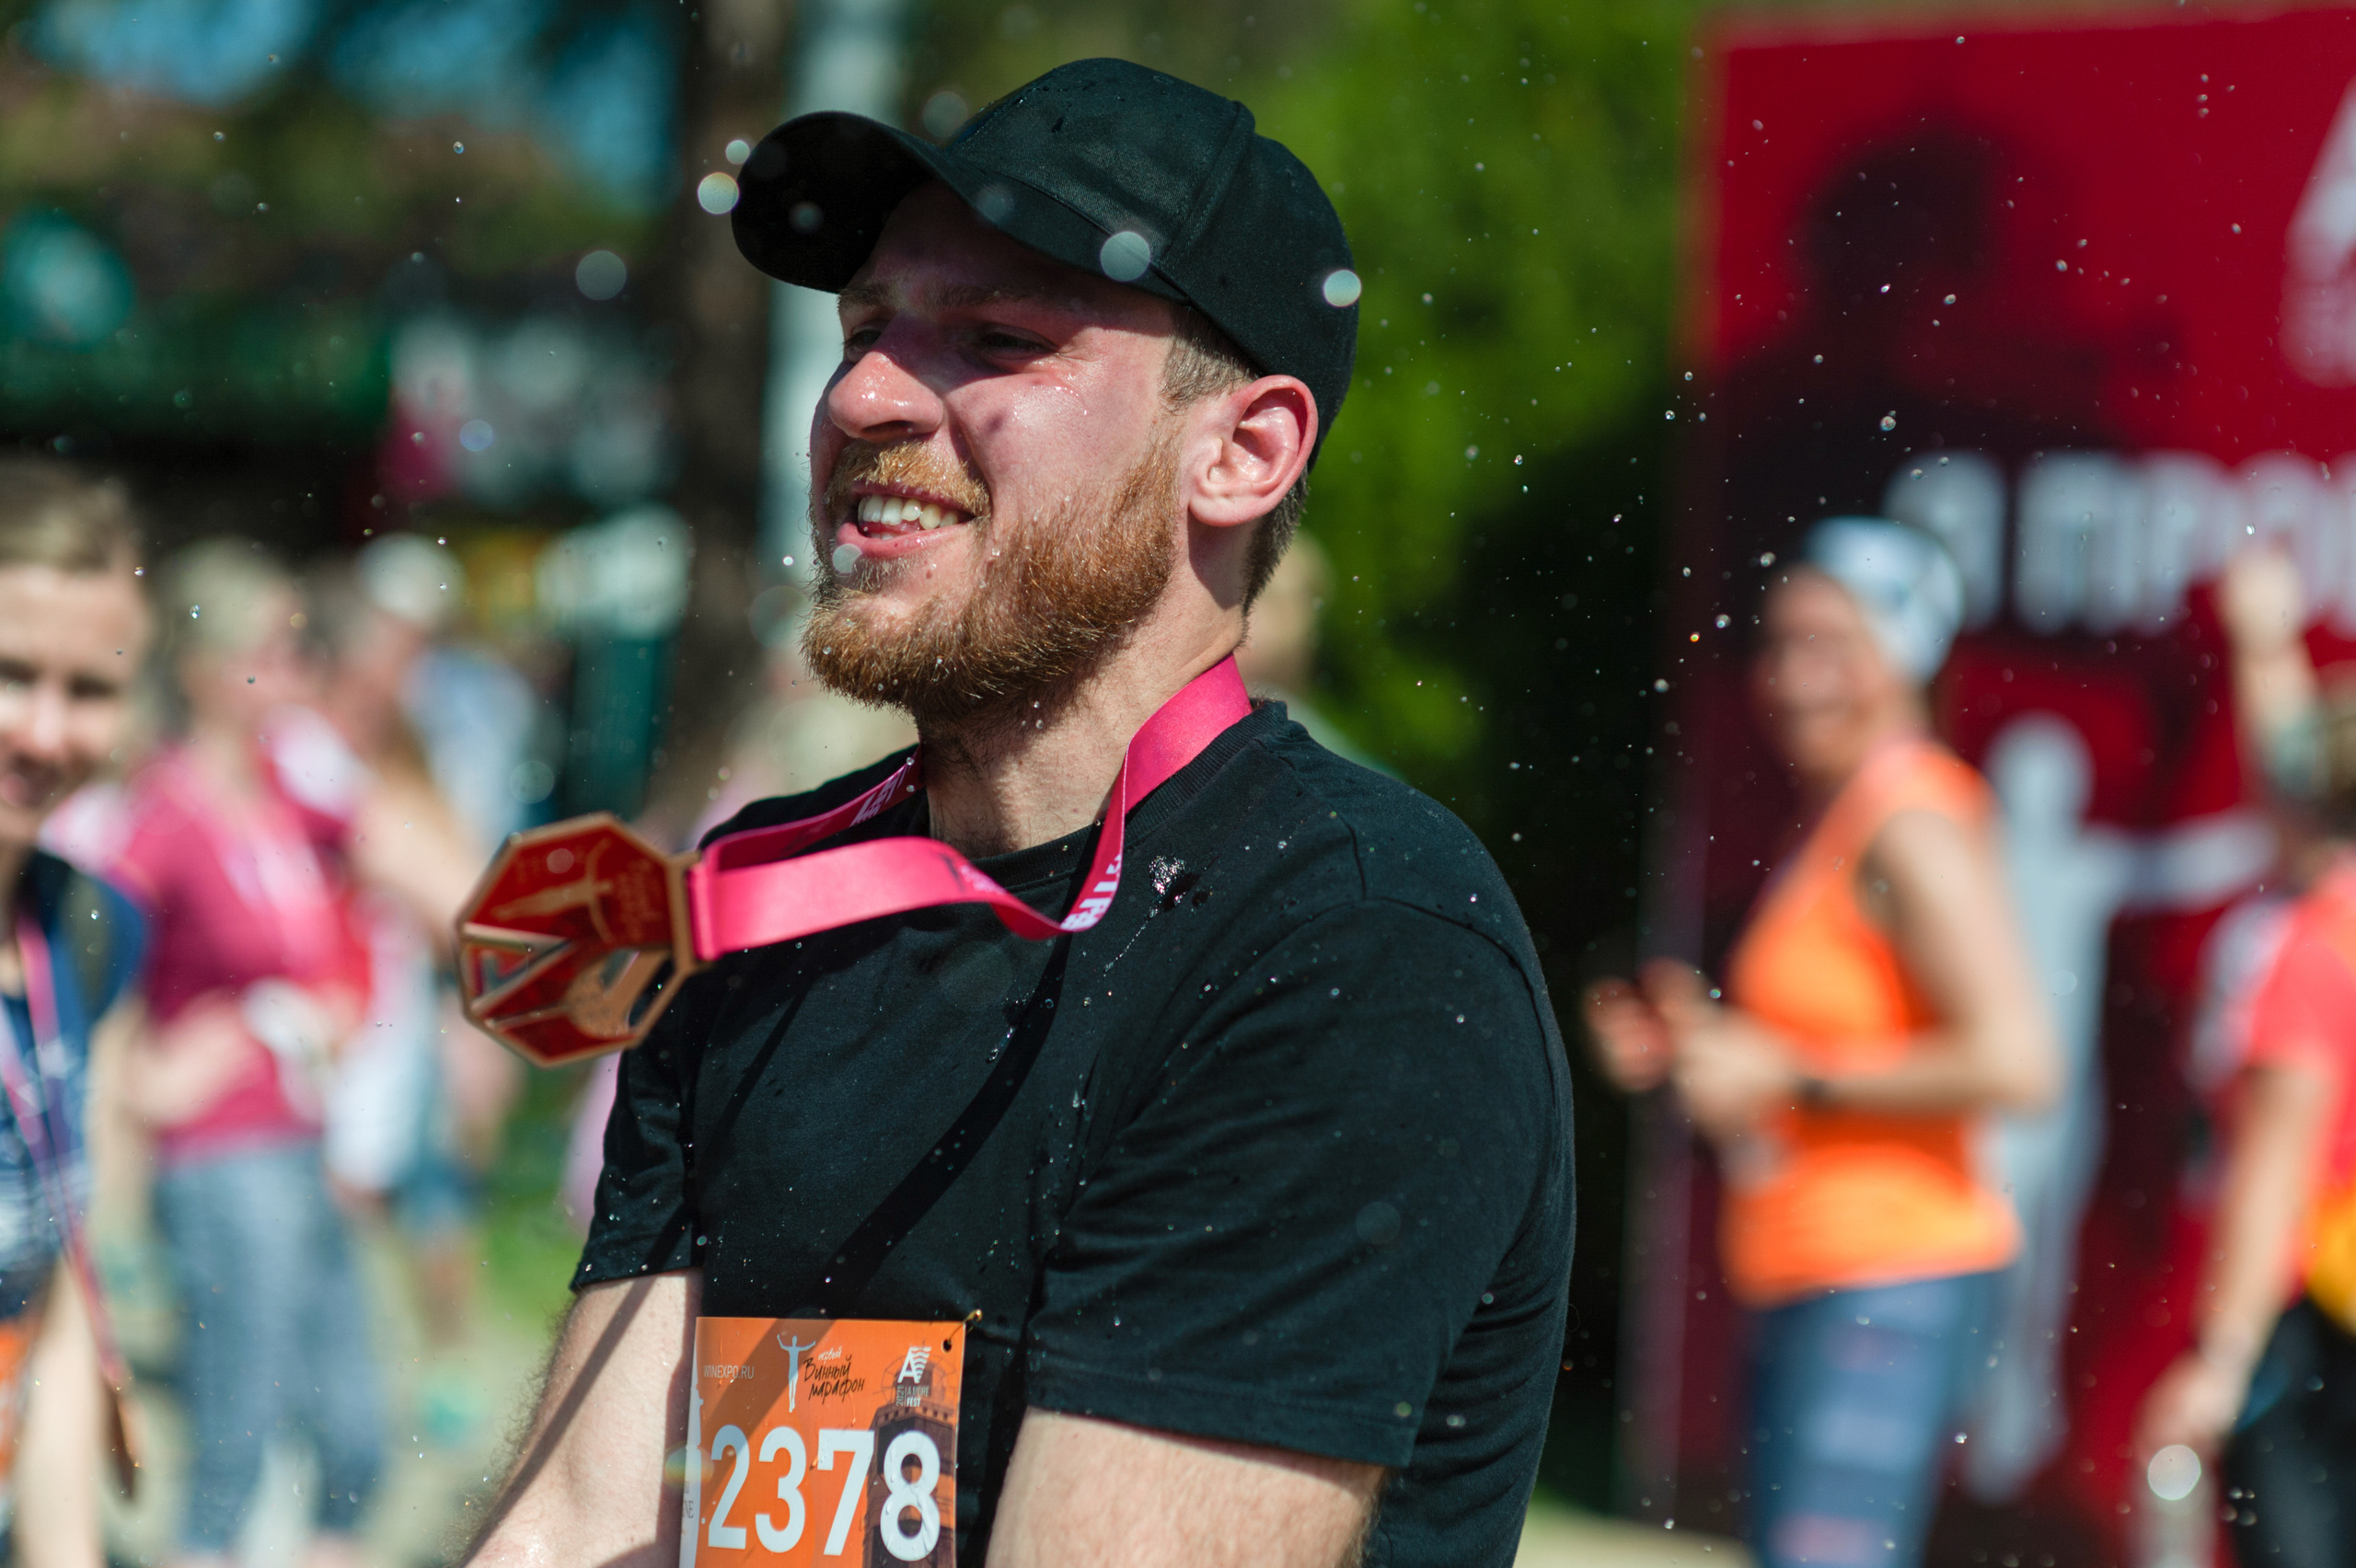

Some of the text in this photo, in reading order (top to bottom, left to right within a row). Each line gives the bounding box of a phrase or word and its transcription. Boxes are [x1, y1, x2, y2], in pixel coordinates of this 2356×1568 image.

[703, 1365, 755, 1379] WINEXPO.RU
[803, 1354, 852, 1382] Винный
[896, 1385, 905, 1406] 2021
[907, 1397, 921, 1407] FEST
[708, 1424, 941, 1562] 2378
